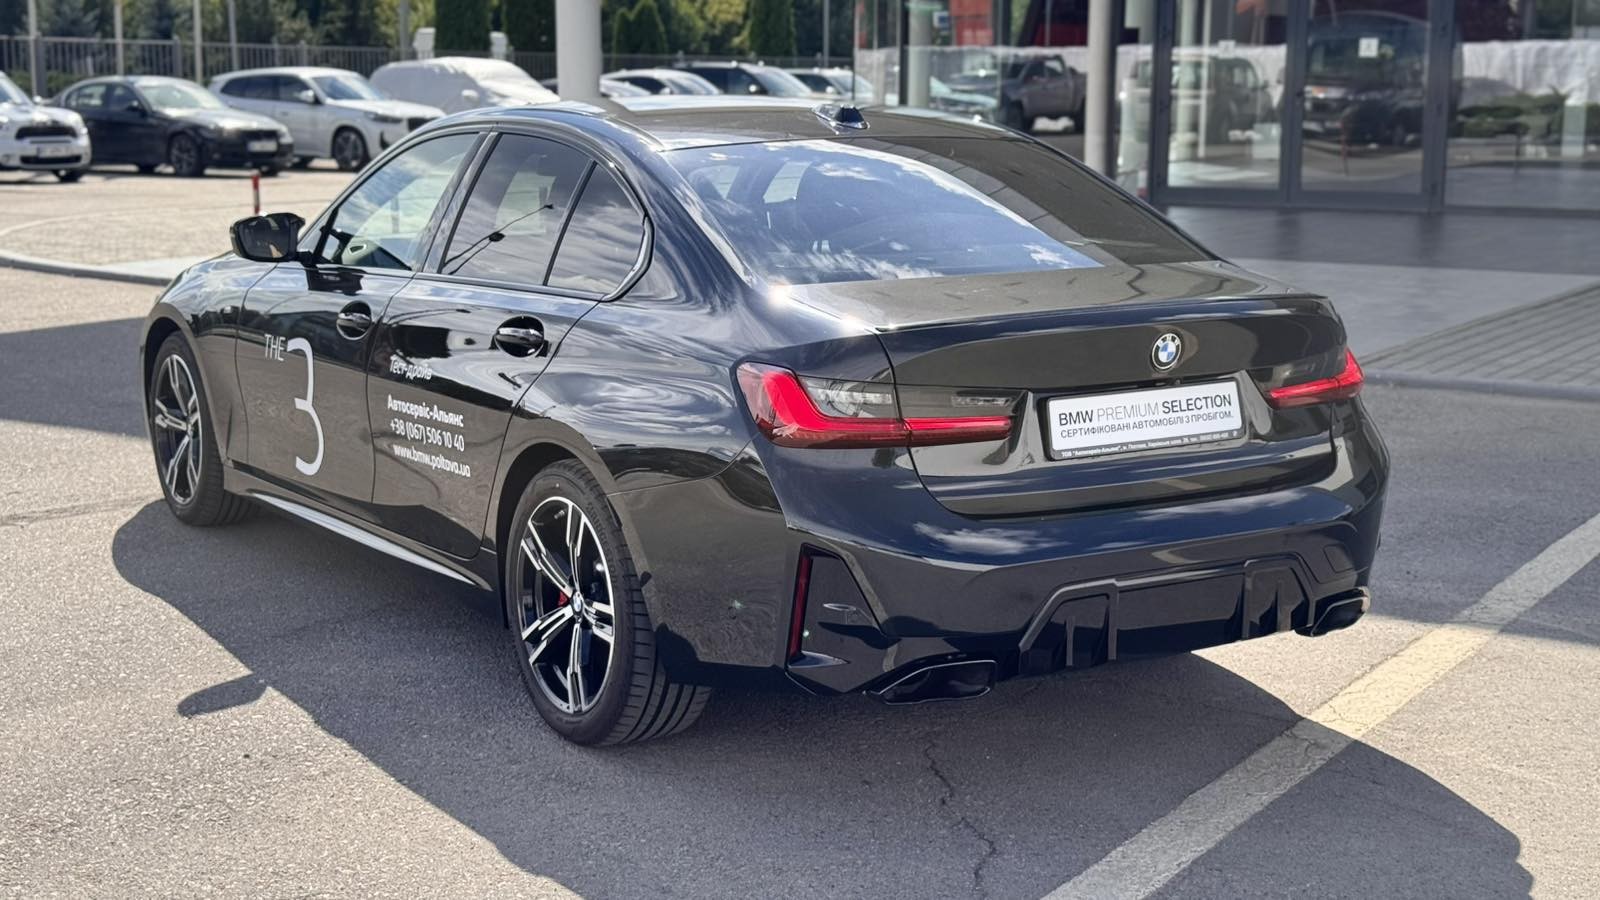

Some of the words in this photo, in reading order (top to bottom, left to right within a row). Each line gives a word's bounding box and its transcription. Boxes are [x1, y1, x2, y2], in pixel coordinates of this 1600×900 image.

[390, 354, 432, 380] Тест-драйв
[264, 334, 286, 361] THE
[286, 337, 324, 476] 3
[388, 394, 464, 427] Автосервіс-Альянс
[1058, 410, 1093, 427] BMW
[1096, 402, 1159, 422] PREMIUM
[1162, 394, 1232, 414] SELECTION
[390, 418, 406, 436] +38
[405, 421, 427, 445] (067)
[426, 426, 443, 446] 506
[442, 431, 453, 449] 10
[453, 434, 465, 452] 40
[1060, 422, 1131, 439] СЕРТИФІКОВАНІ
[1132, 416, 1184, 430] АВТОМОБІЛІ
[392, 444, 471, 477] www.bmw.poltava.ua
